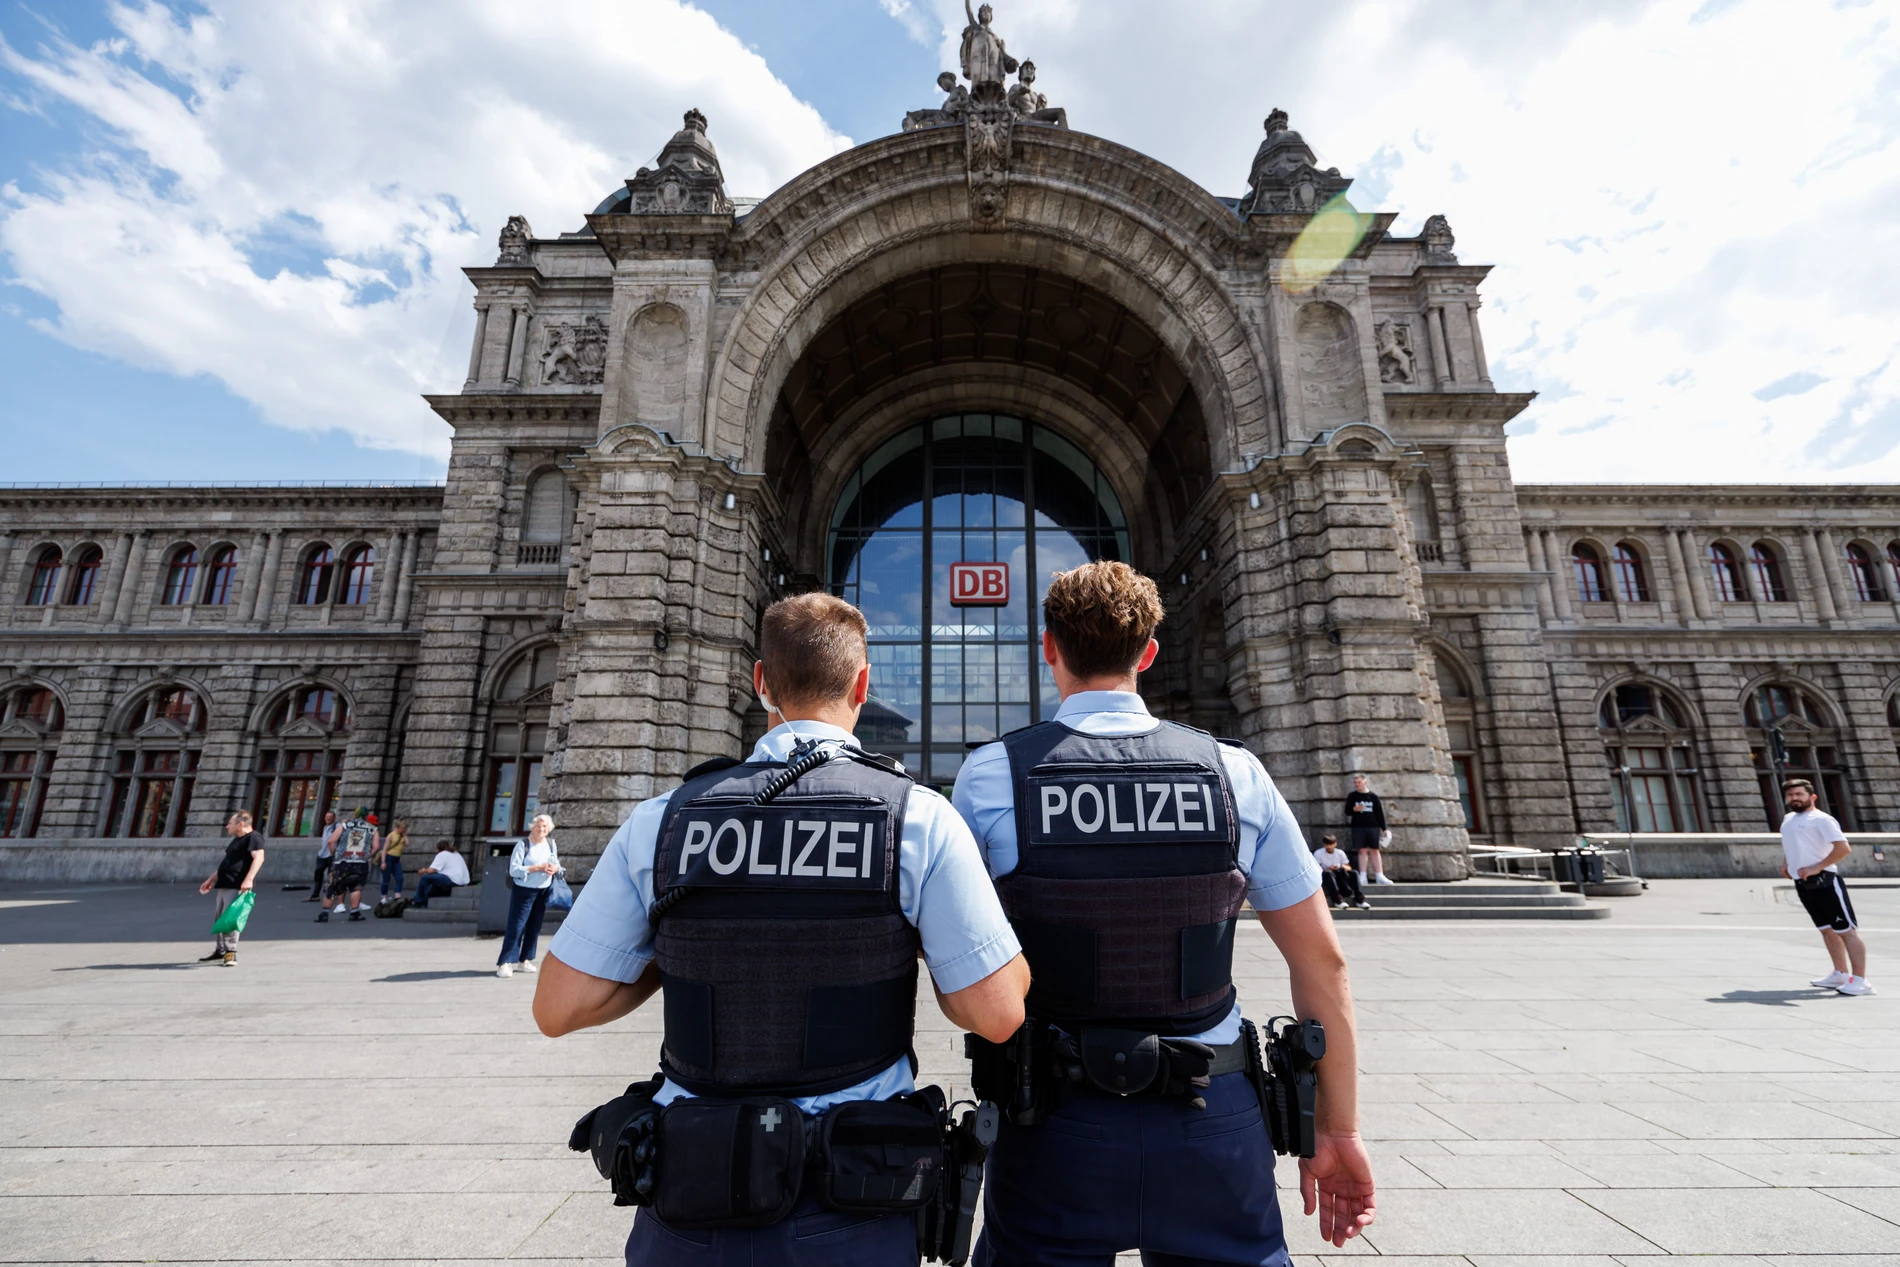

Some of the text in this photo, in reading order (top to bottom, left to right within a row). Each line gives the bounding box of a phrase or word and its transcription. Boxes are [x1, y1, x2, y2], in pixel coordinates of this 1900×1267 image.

[959, 570, 1003, 597] DB
[1040, 783, 1216, 834] POLIZEI
[678, 818, 874, 878] POLIZEI
